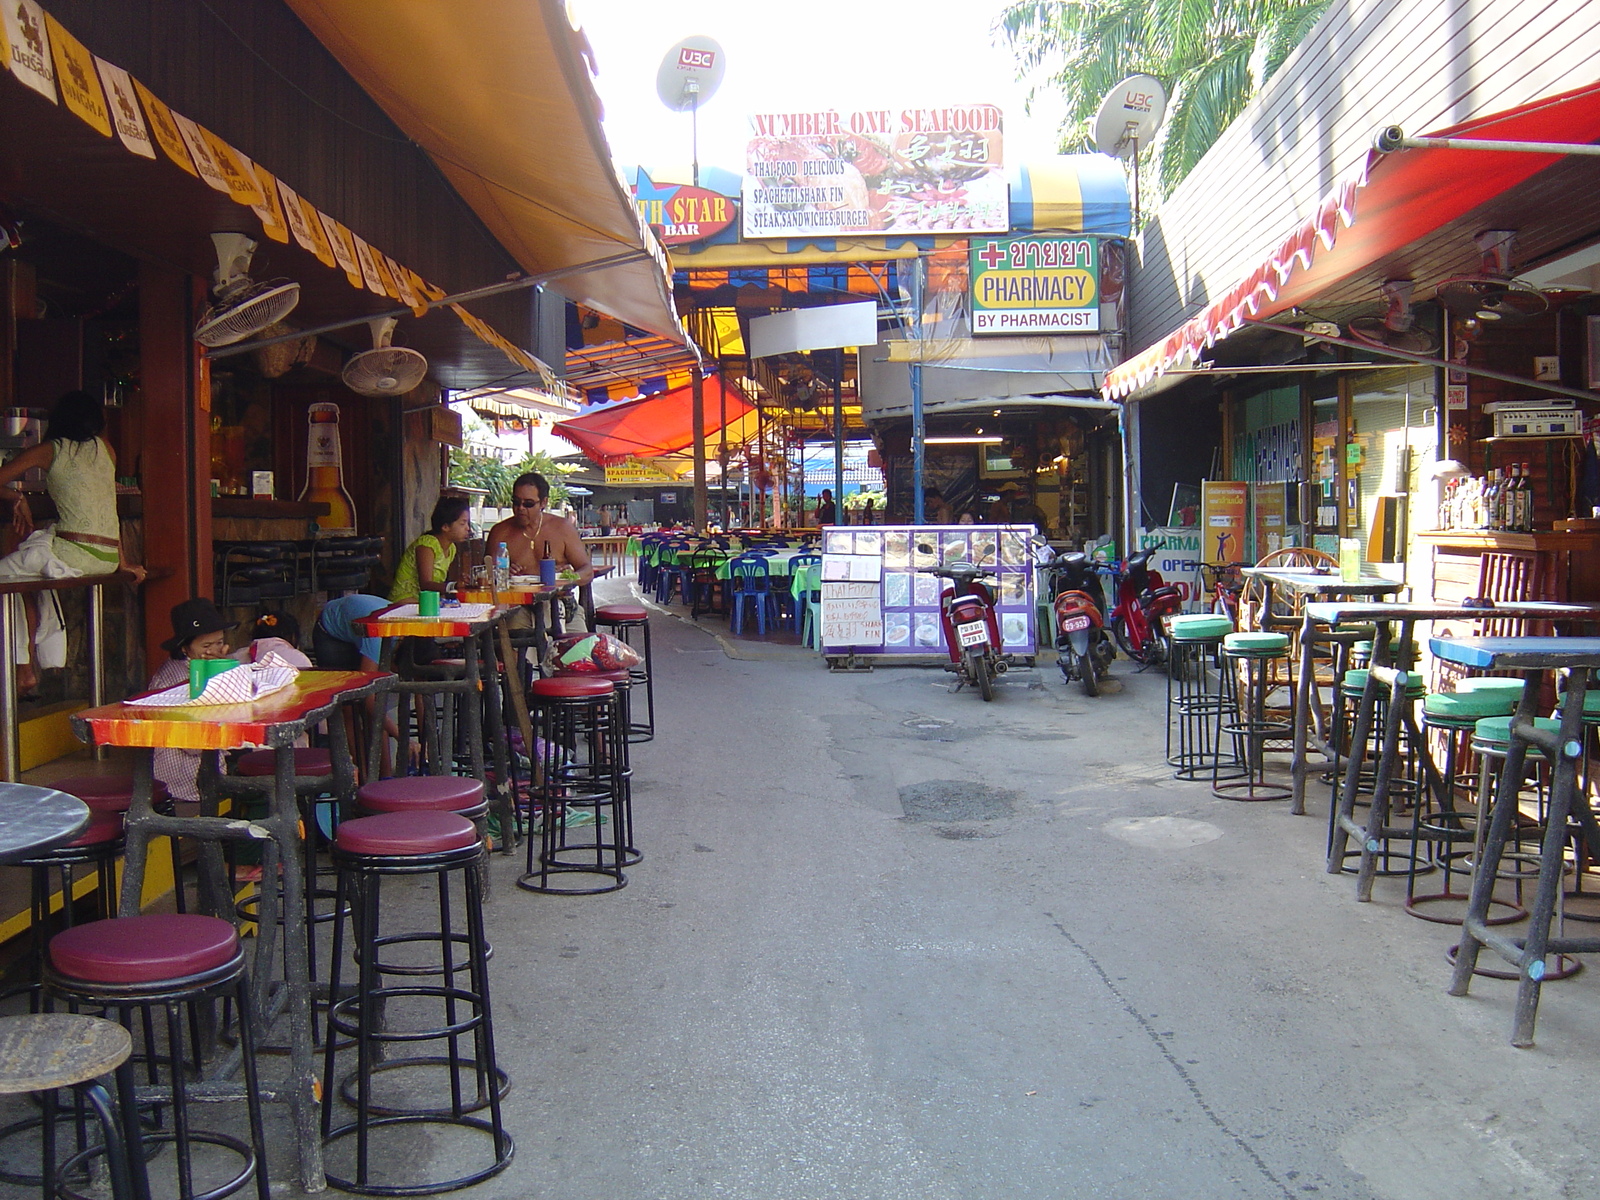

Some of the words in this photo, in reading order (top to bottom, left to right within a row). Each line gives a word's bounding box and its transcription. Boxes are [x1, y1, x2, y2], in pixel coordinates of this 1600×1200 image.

[755, 112, 840, 137] NUMBER
[850, 110, 892, 135] ONE
[901, 107, 1000, 133] SEAFOOD
[803, 159, 845, 176] DELICIOUS
[830, 186, 844, 202] FIN
[673, 196, 727, 223] STAR
[664, 223, 700, 236] BAR
[1009, 240, 1092, 268] ขายยา
[983, 275, 1087, 301] PHARMACY
[978, 314, 996, 327] BY
[1000, 312, 1091, 327] PHARMACIST
[865, 630, 881, 638] FIN
